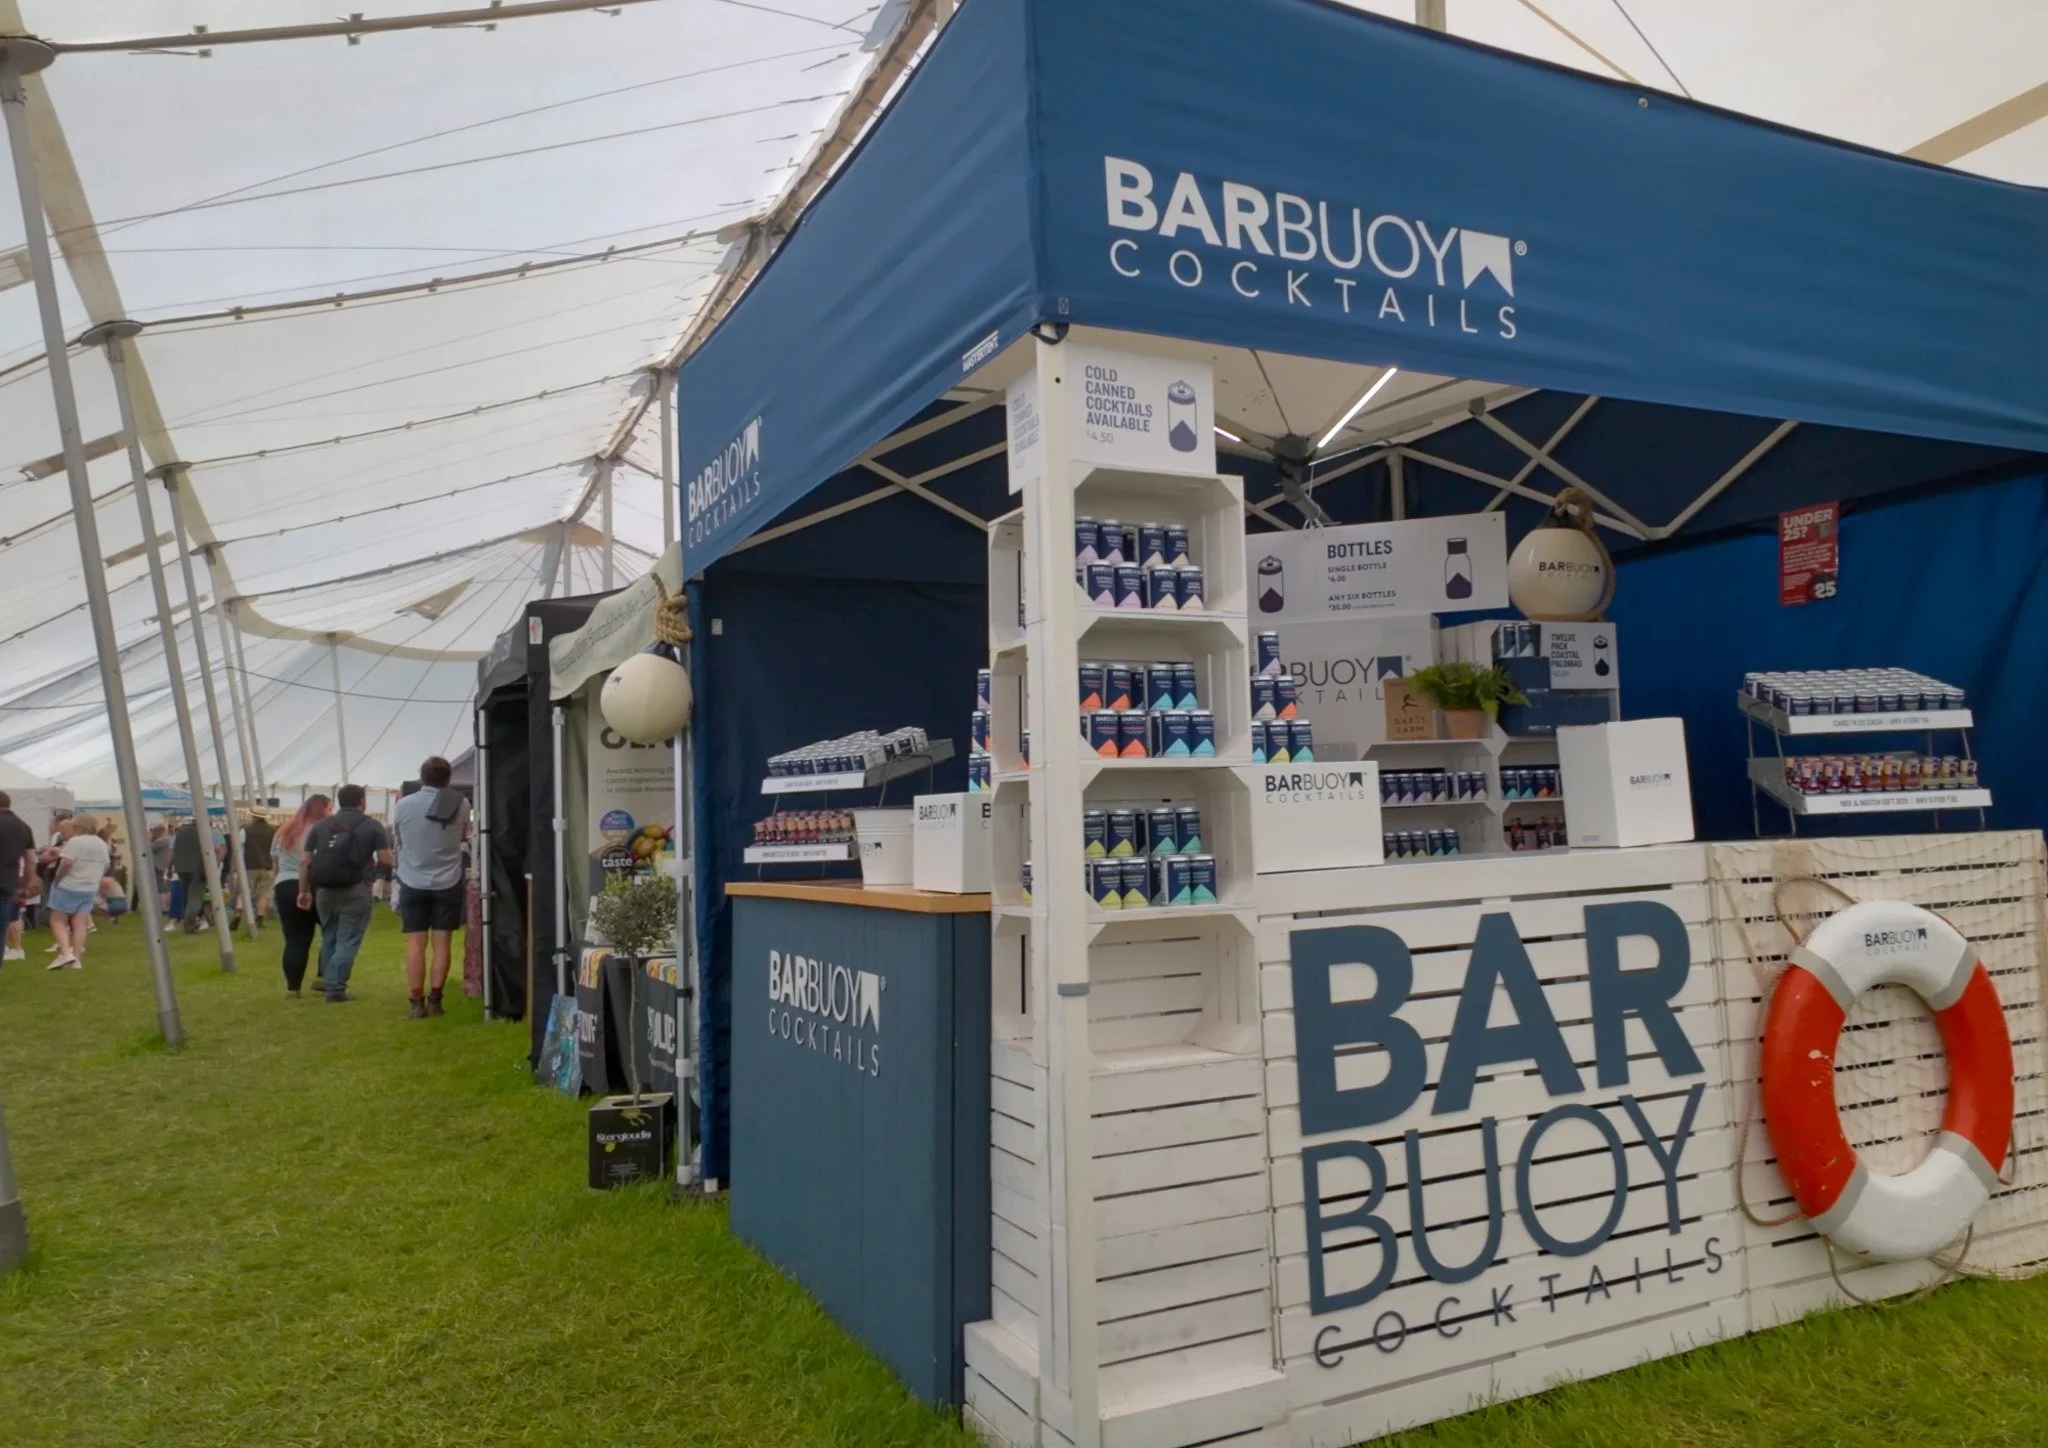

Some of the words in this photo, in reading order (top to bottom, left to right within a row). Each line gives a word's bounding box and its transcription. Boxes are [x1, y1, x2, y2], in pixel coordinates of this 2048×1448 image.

[1104, 156, 1459, 287] BARBUOY
[1109, 239, 1517, 339] COCKTAILS
[1085, 365, 1118, 382] COLD
[1086, 381, 1135, 400] CANNED
[1086, 396, 1153, 418] COCKTAILS
[1086, 413, 1150, 432] AVAILABLE
[689, 432, 746, 523] BARBUOY
[689, 472, 760, 548] COCKTAILS
[1783, 508, 1833, 529] UNDER
[1784, 525, 1808, 542] 25?
[1327, 540, 1393, 559] BOTTLES
[1328, 564, 1355, 573] SINGLE
[1357, 562, 1387, 571] BOTTLE
[1539, 562, 1595, 574] BARBUOY
[1347, 593, 1360, 601] SIX
[1361, 590, 1397, 599] BOTTLES
[1814, 581, 1837, 599] 25
[1264, 772, 1349, 793] BARBUOY
[1265, 790, 1365, 804] COCKTAILS
[602, 858, 634, 868] taste
[1864, 929, 1918, 948] BARBUOY
[768, 950, 862, 1028] BARBUOY
[1289, 900, 1706, 1137] BAR
[768, 1007, 880, 1077] COCKTAILS
[1301, 1082, 1707, 1317] BUOY
[1313, 1236, 1724, 1369] COCKTAILS
